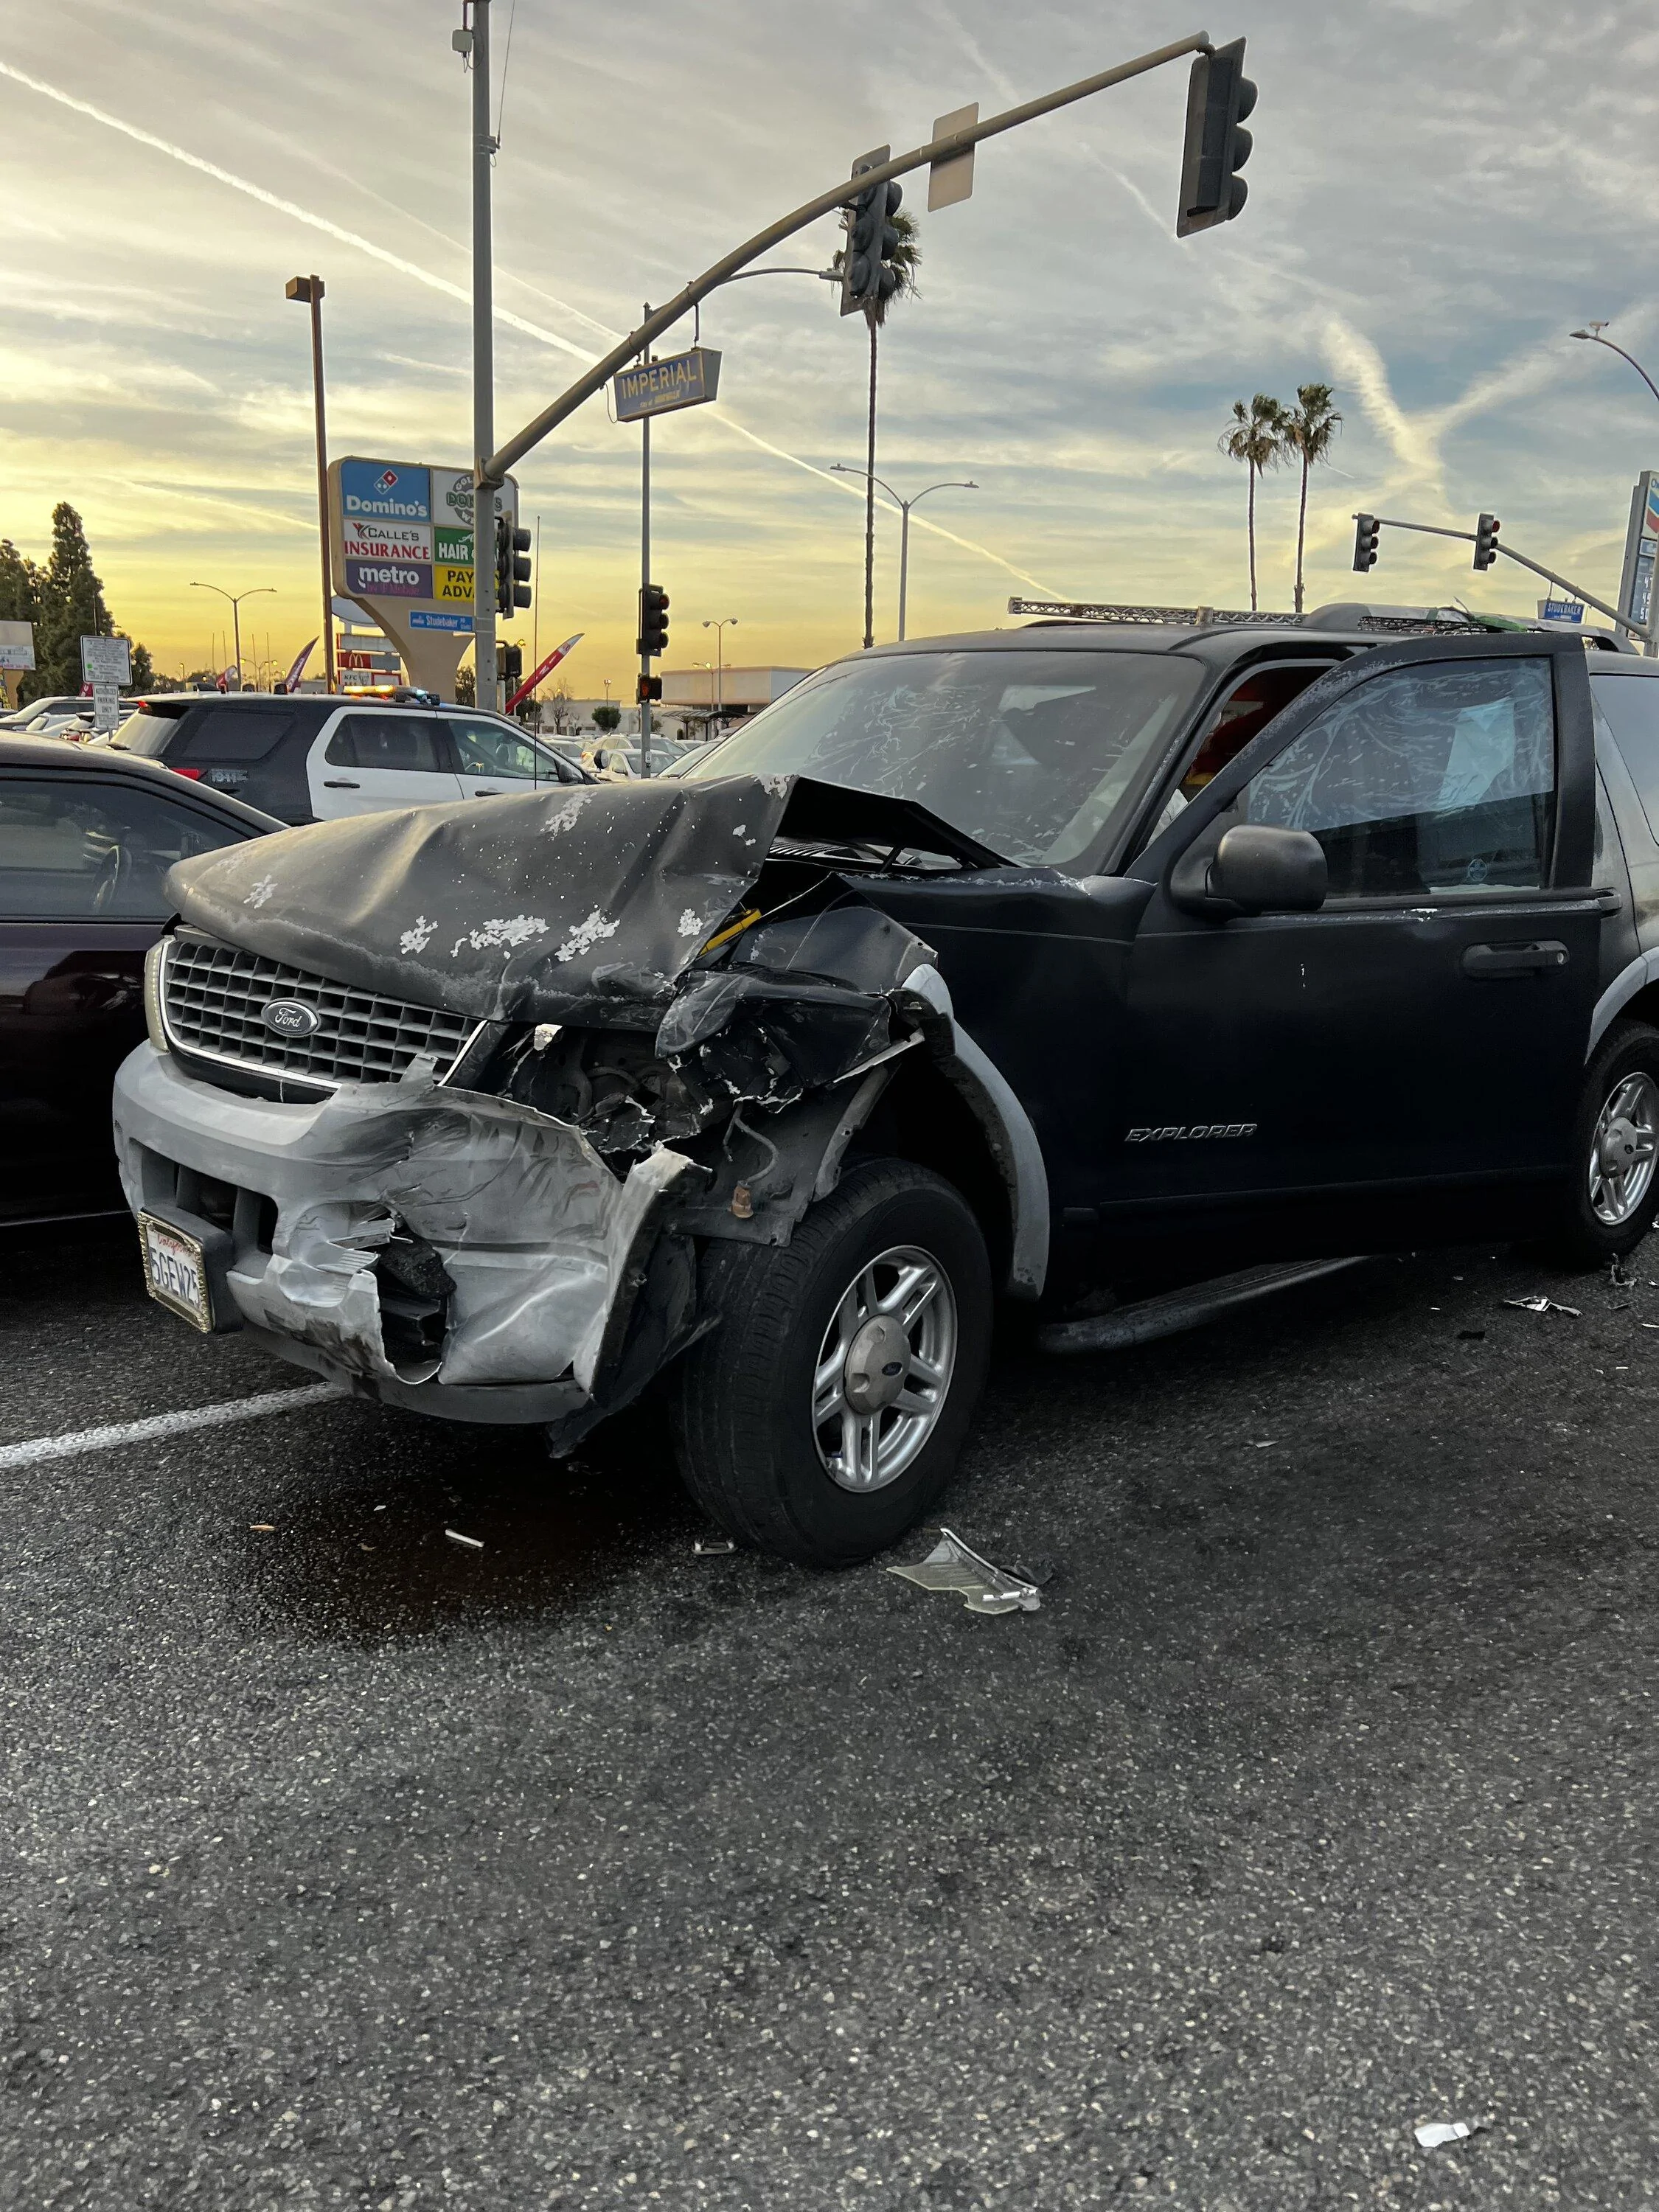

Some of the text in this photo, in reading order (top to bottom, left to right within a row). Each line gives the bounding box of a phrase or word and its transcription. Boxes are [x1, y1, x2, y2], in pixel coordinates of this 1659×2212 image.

[622, 360, 696, 399] IMPERIAL
[456, 476, 473, 490] GOL
[347, 495, 428, 517] Domino's
[344, 540, 430, 560] INSURANCE
[438, 542, 468, 560] HAIR
[358, 566, 420, 588] metro
[448, 570, 474, 583] PAY
[1547, 602, 1582, 615] STUDEBAKER
[425, 615, 458, 627] Studebaker
[275, 1007, 302, 1027] Ford
[1124, 1123, 1258, 1142] EXPLORER
[150, 1246, 200, 1309] 5GEW25
